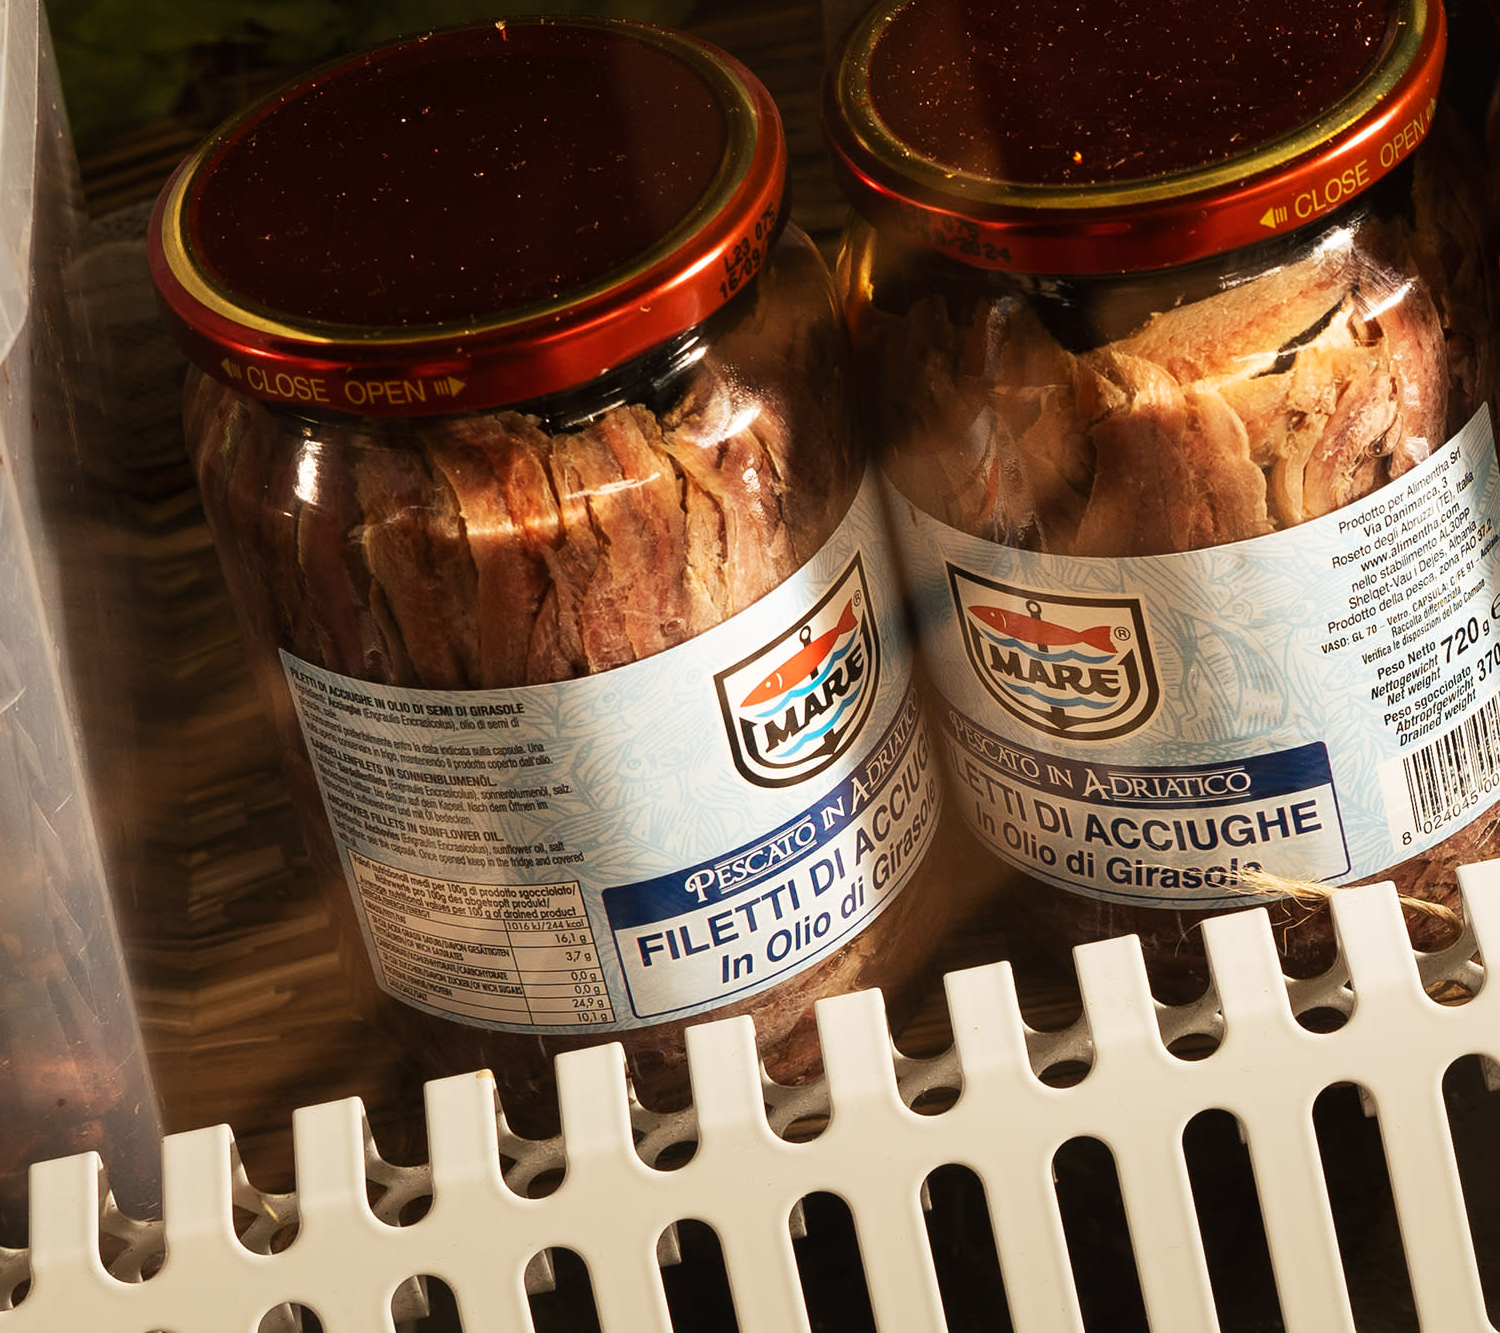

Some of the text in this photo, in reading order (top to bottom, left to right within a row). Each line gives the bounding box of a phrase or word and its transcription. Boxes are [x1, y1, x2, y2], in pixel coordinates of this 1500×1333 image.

[1295, 113, 1425, 218] CLOSE OPEN
[247, 366, 427, 404] CLOSE OPEN
[1338, 446, 1462, 535] Prodotto per Alimentha Srl
[1363, 477, 1449, 538] Via Danimarca, 3
[1331, 543, 1372, 570] Roseto
[1374, 530, 1399, 551] degli
[1401, 506, 1435, 534] Abruzzi
[1351, 573, 1378, 593] nello
[1380, 538, 1438, 576] stabilimento
[1439, 506, 1471, 543] AL30PP
[1360, 501, 1461, 573] www.alimentha.com
[1418, 547, 1448, 574] Dejes,
[1448, 519, 1477, 550] Albania
[1327, 607, 1377, 634] Prodotto
[1379, 593, 1404, 612] della
[1406, 572, 1438, 600] pesca,
[1439, 555, 1460, 575] zona
[1460, 537, 1477, 559] FAO
[1321, 635, 1350, 654] VASO:
[1352, 630, 1364, 644] GL
[1366, 625, 1378, 637] 70
[1386, 609, 1412, 627] Vetro.
[1412, 582, 1450, 612] CAPSULA:
[1361, 645, 1392, 665] Verifica
[1402, 614, 1442, 646] disposizioni
[1442, 606, 1453, 621] del
[1391, 612, 1423, 639] Raccolta
[990, 645, 1122, 698] MARE
[1370, 654, 1439, 701] Nettogewicht
[1440, 616, 1479, 666] 720
[1482, 619, 1490, 637] g
[1377, 641, 1436, 681] Peso Netto
[1387, 667, 1441, 707] Net weight
[426, 702, 525, 717] SEMI GIRASOLE
[764, 645, 864, 753] MARE
[1383, 666, 1472, 726] Peso sgocciolato
[1396, 675, 1474, 735] Abtropfgewicht
[1399, 688, 1478, 747] Drained weight
[1046, 764, 1074, 790] IN
[419, 824, 505, 843] SUNFLOWER OIL.
[821, 798, 846, 831] IN
[976, 801, 997, 837] In
[1002, 820, 1058, 866] Olio
[1066, 849, 1095, 879] di
[1034, 799, 1073, 839] DI
[1084, 799, 1323, 852] ACCIUGHE
[1401, 830, 1413, 847] 8
[1423, 791, 1479, 836] 024045
[479, 885, 517, 900] prodotto
[637, 880, 800, 967] FILETTI
[810, 846, 847, 897] DI
[722, 778, 937, 984] In Olio di Girasole
[504, 906, 577, 920] drained product
[555, 933, 576, 945] 16,1
[572, 997, 595, 1009] 24,9
